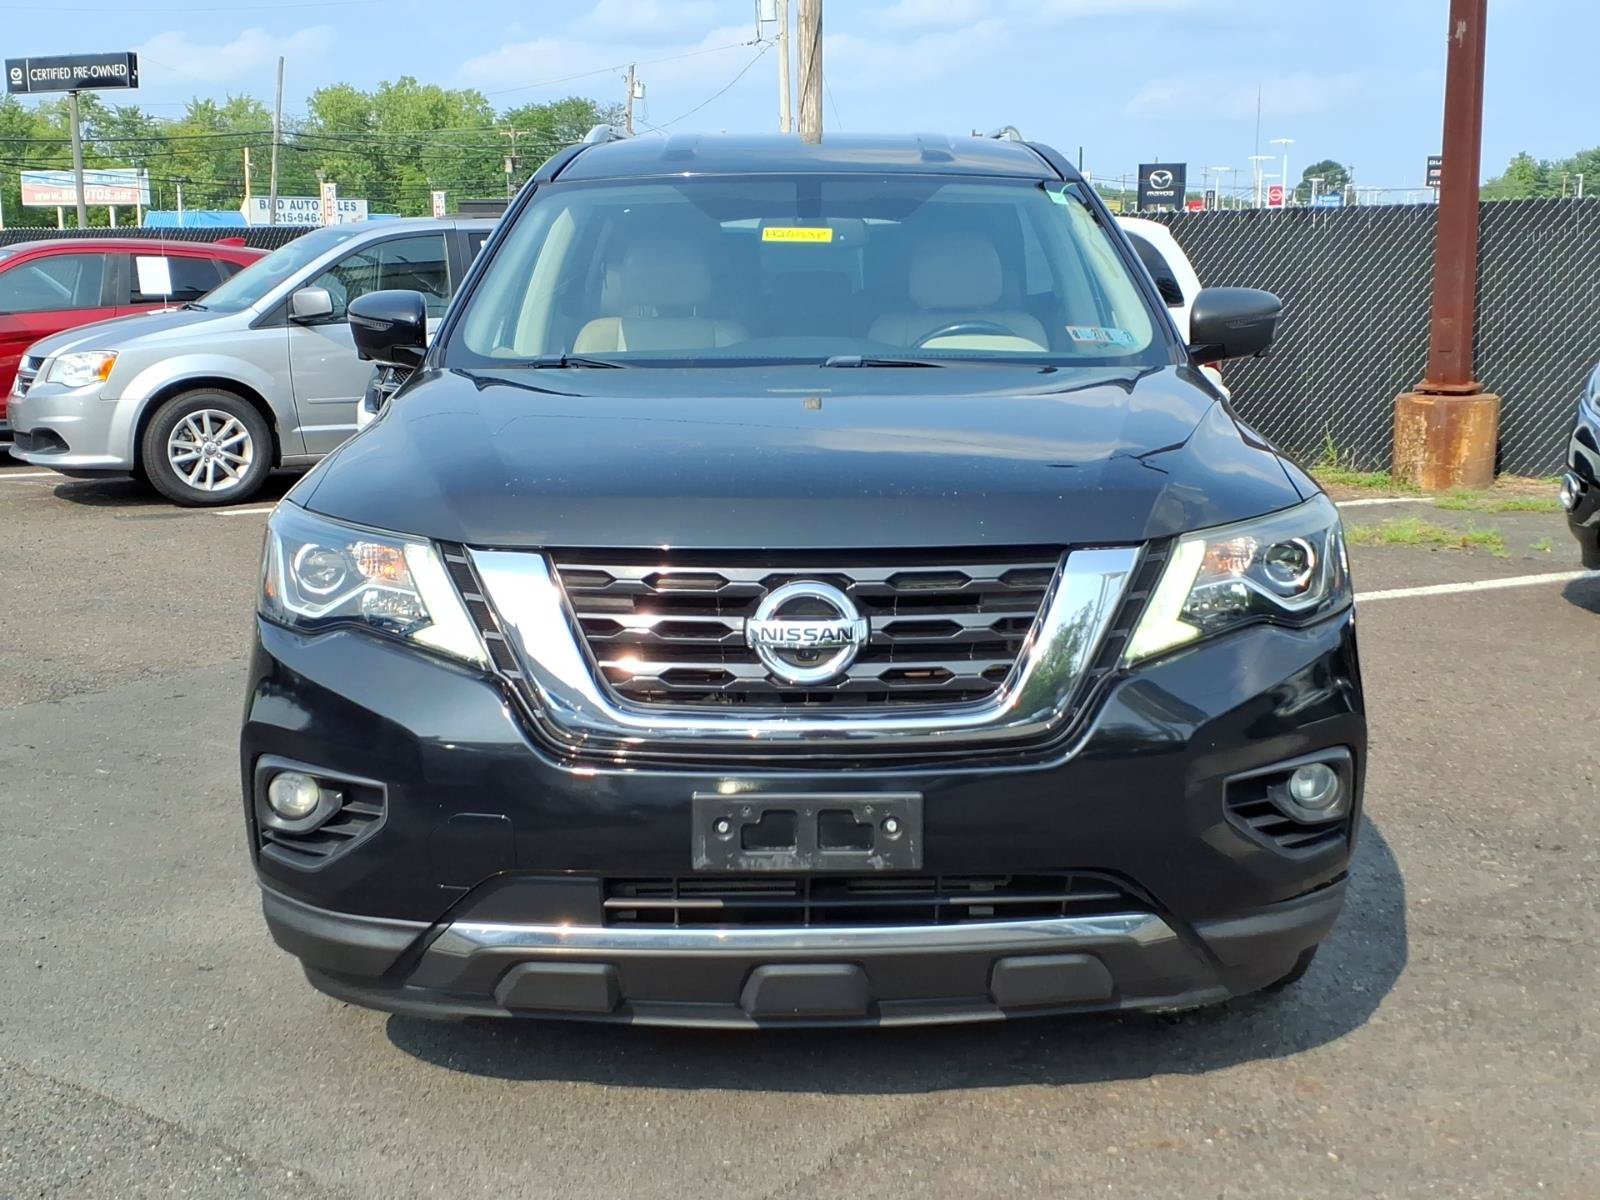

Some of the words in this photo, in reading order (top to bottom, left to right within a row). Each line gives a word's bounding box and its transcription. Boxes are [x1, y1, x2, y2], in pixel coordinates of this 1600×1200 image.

[30, 68, 71, 81] CERTIFIED
[73, 64, 127, 78] PRE-OWNED
[290, 200, 319, 211] AUTO
[760, 626, 853, 641] NISSAN
